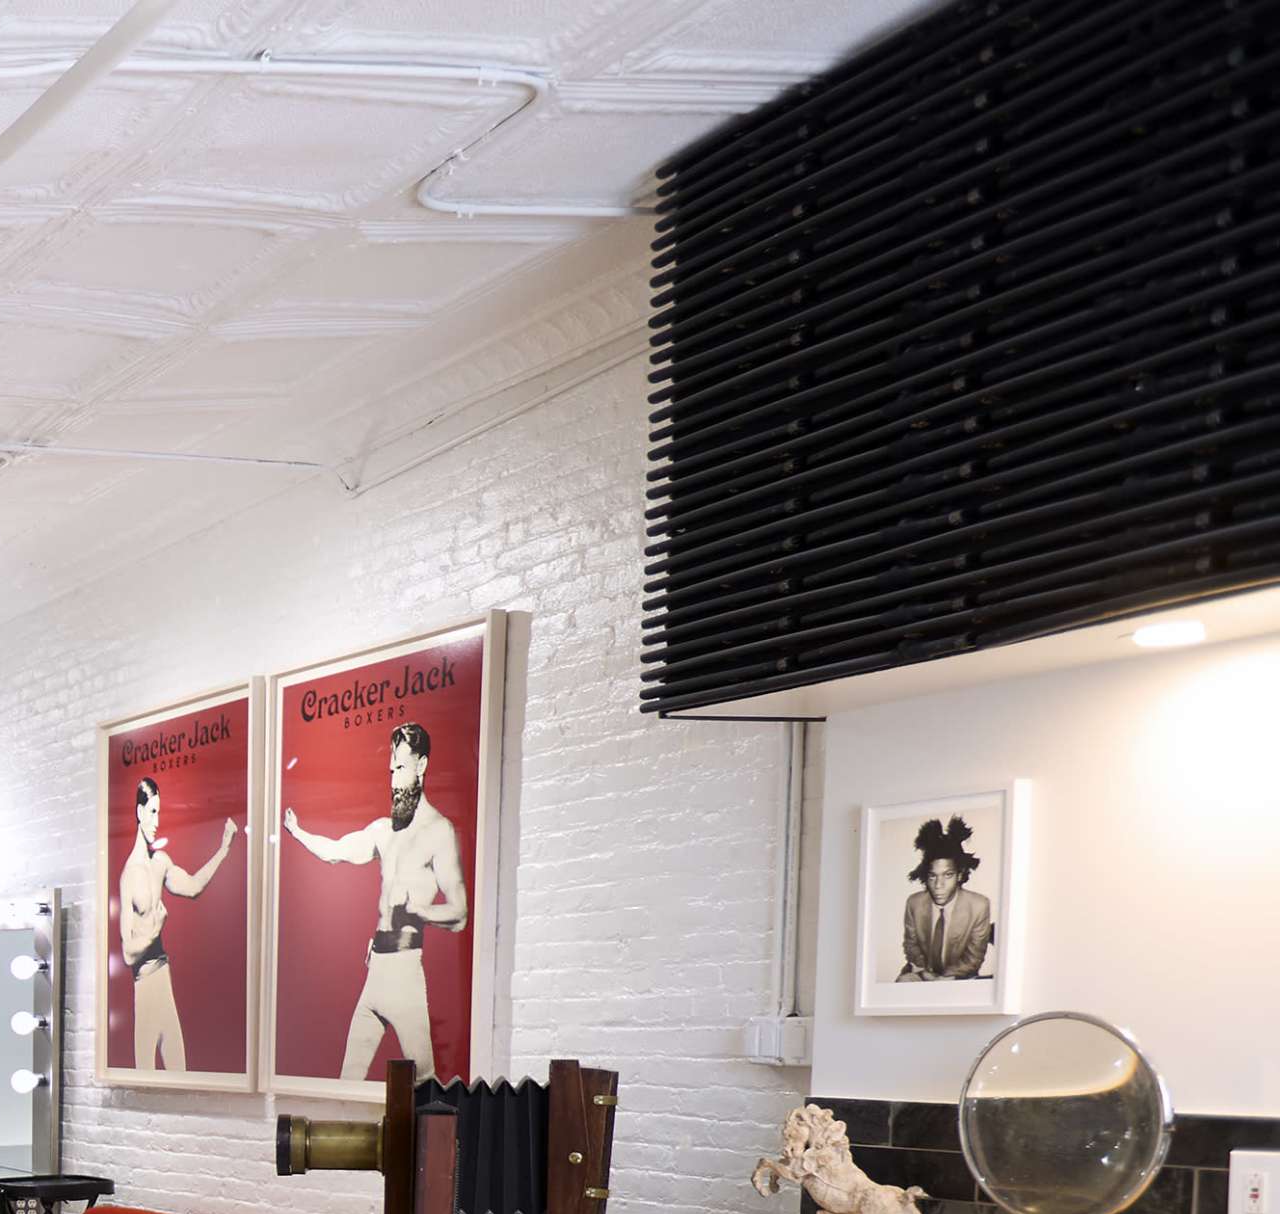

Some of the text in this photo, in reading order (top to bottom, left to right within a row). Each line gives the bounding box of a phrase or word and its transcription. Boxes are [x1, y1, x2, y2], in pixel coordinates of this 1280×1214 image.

[301, 656, 456, 722] Cracker Jack
[344, 704, 406, 729] BOXERS
[121, 713, 231, 767] Cracker Jack
[153, 753, 197, 773] BOXERS
